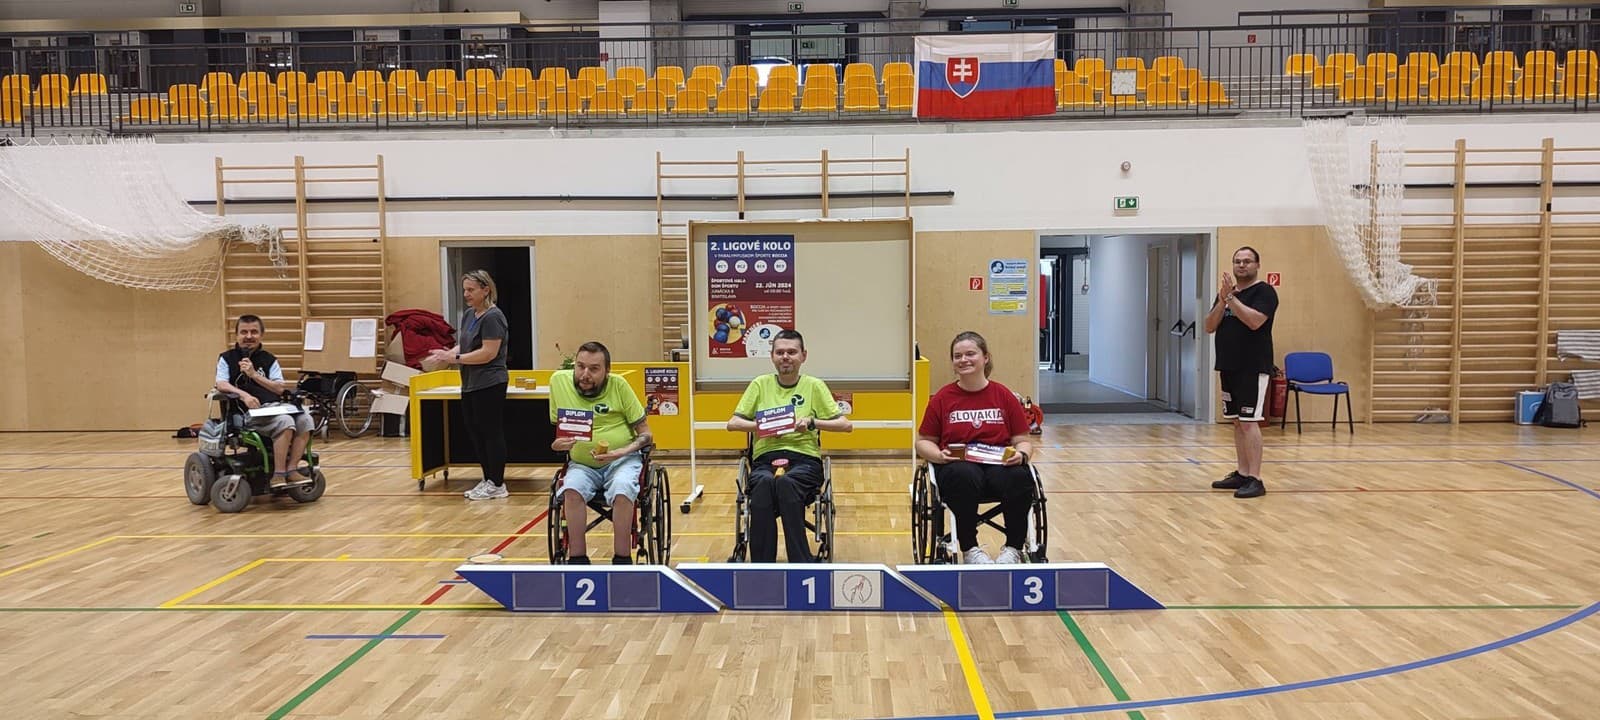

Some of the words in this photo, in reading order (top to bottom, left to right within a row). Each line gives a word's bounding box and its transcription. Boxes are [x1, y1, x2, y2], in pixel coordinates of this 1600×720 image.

[710, 242, 720, 250] 2.
[723, 240, 760, 250] LIGOVÉ
[763, 242, 791, 250] KOLO
[764, 407, 786, 416] DIPLOM
[950, 410, 1004, 422] SLOVAKIA
[576, 578, 596, 606] 2
[802, 576, 816, 604] 1
[1024, 576, 1044, 604] 3
